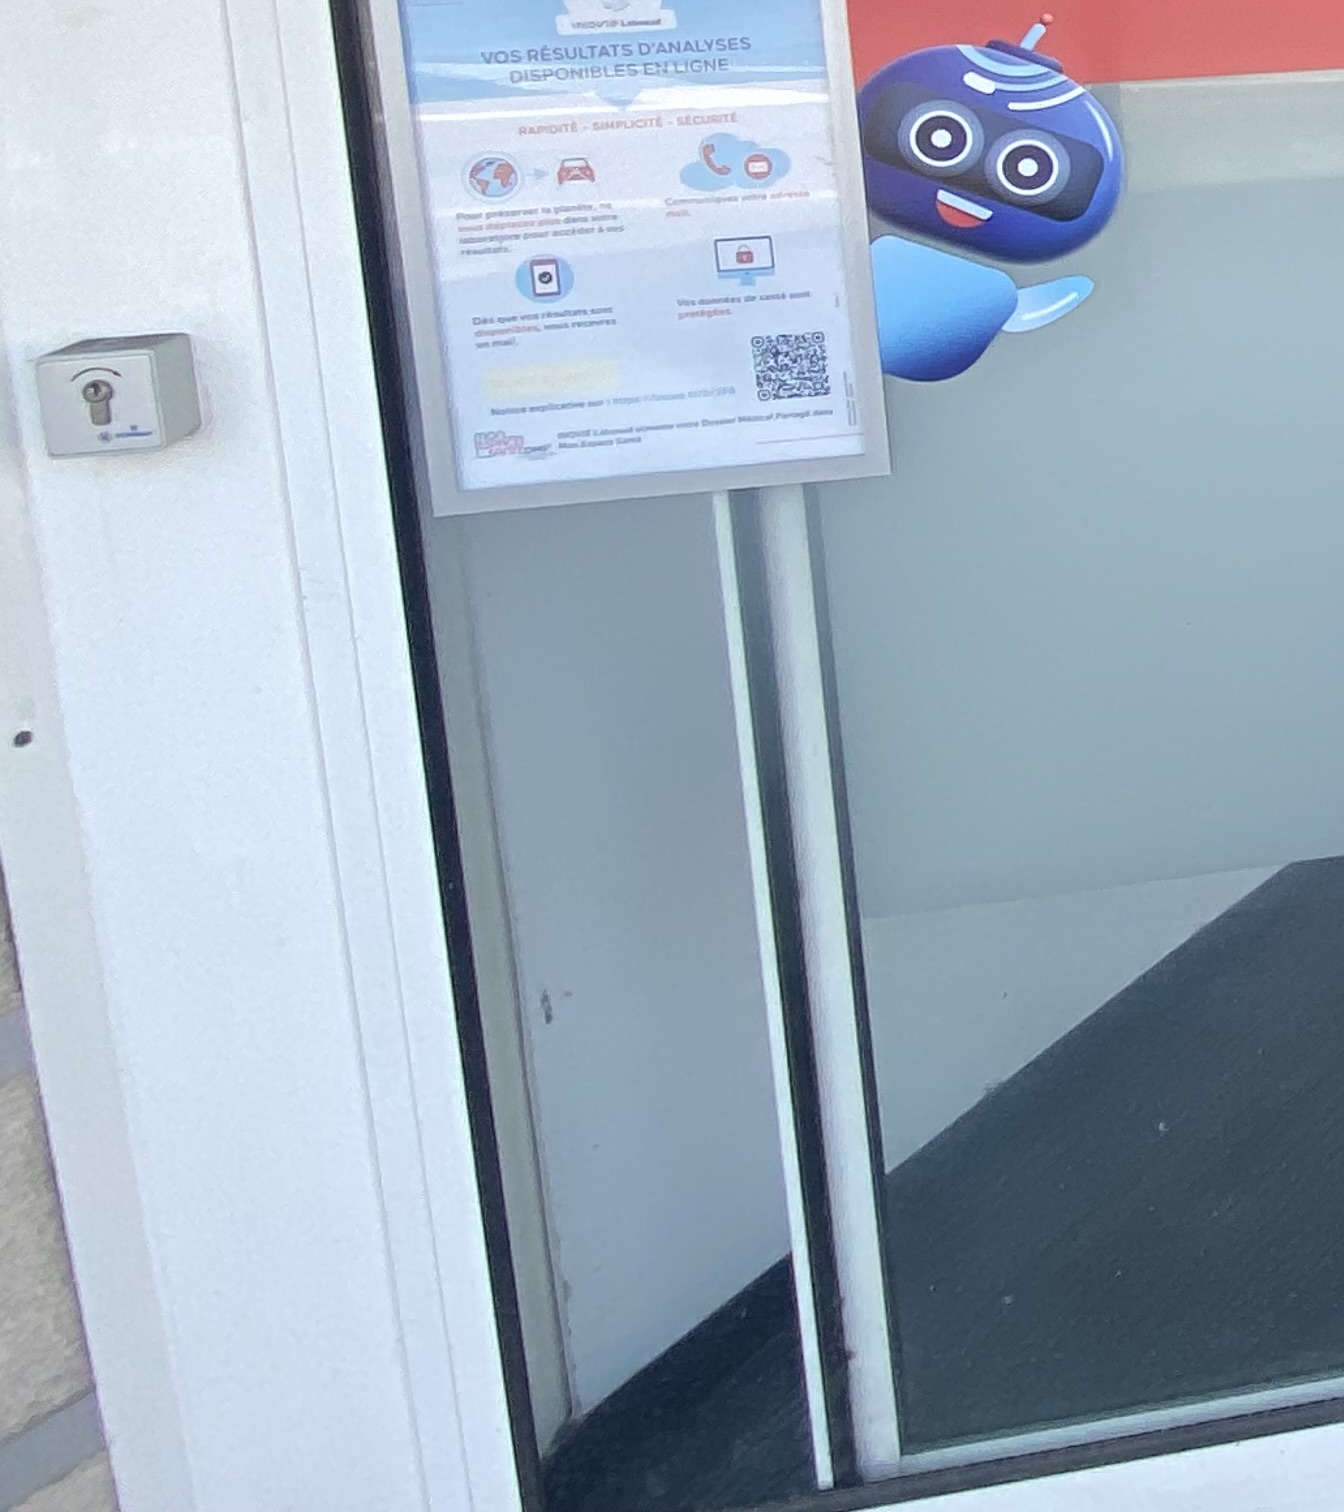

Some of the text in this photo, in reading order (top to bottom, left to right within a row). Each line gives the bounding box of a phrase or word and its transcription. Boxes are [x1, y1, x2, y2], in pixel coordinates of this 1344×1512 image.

[480, 36, 752, 65] VOS RÉSULTATS D'ANALYSES
[509, 58, 730, 84] DISPONIBLES EN LIGNE
[518, 122, 579, 136] RAPIDITÉ
[592, 115, 663, 131] SIMPLICITÉ
[676, 112, 738, 127] SÉCURITÉ
